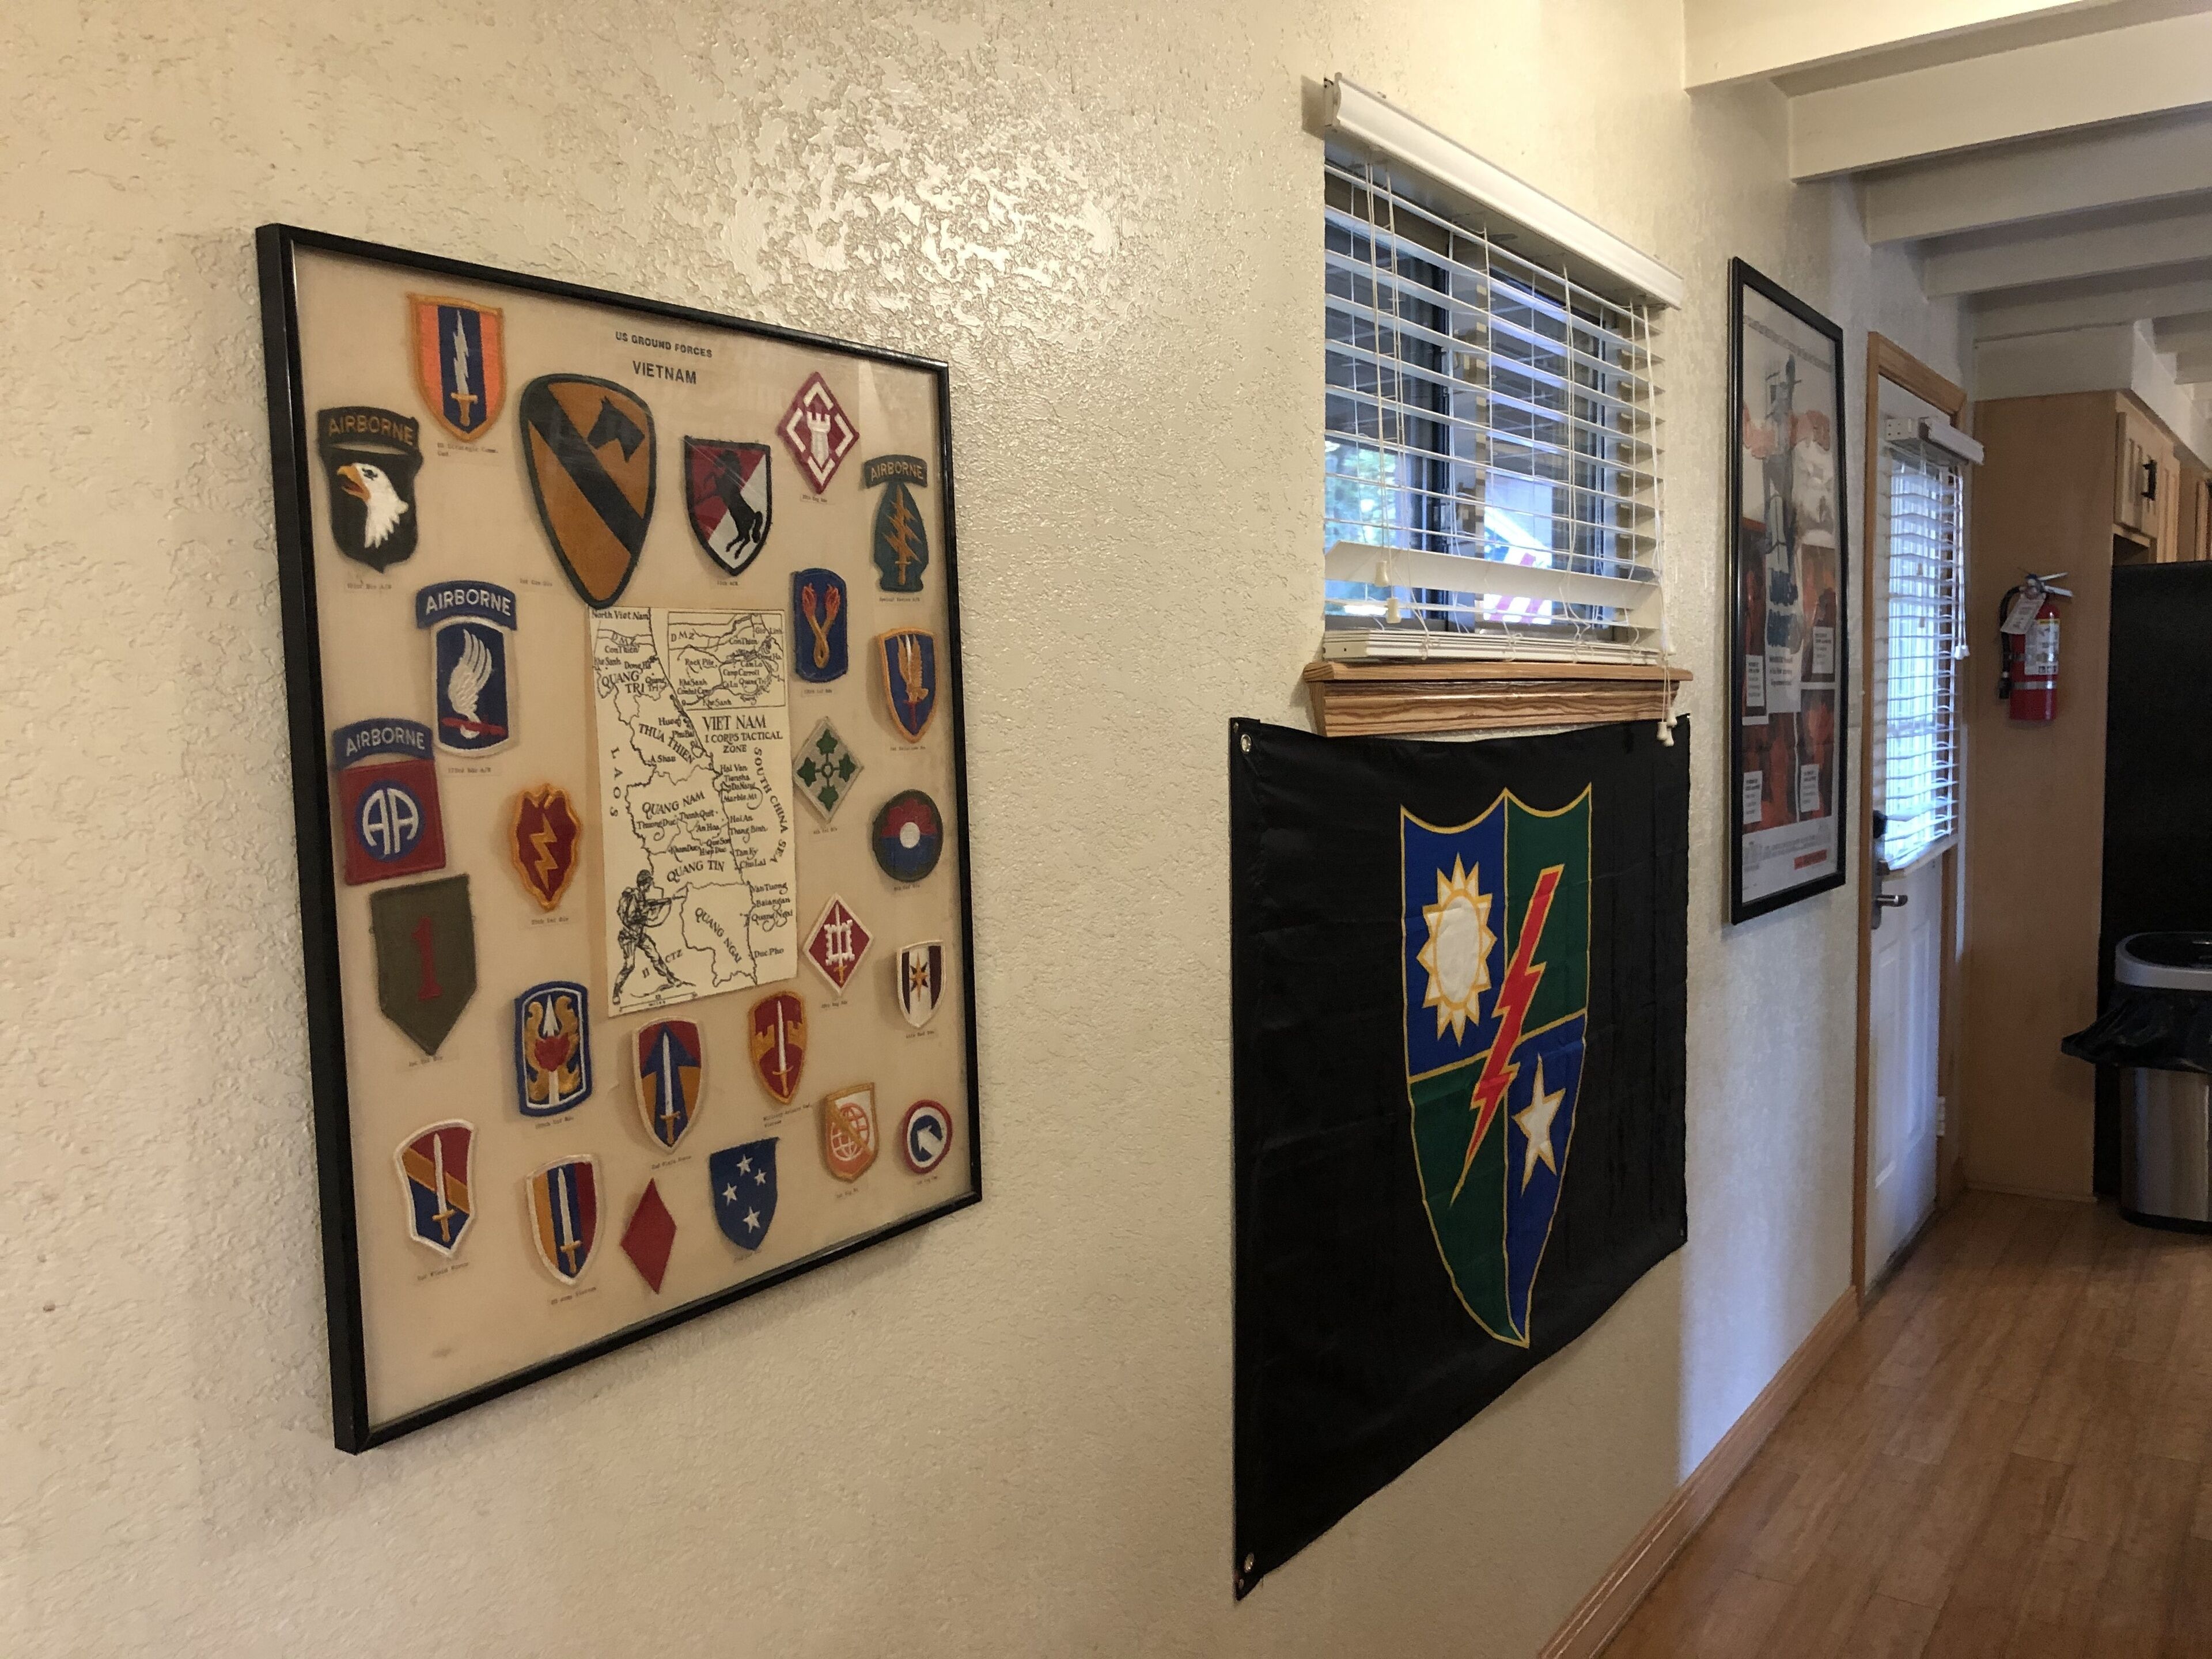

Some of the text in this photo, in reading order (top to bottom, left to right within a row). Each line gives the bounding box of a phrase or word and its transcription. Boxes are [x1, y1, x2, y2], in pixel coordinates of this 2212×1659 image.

[616, 331, 713, 358] US GROUND FORCES
[632, 360, 697, 385] VIETNAM
[328, 415, 414, 446] AIRBORNE
[871, 461, 923, 482] AIRBORNE
[426, 589, 511, 616] AIRBORNE
[592, 610, 649, 620] North Viet Nam
[601, 671, 639, 689] QUANG
[625, 683, 645, 694] TRI
[702, 714, 767, 732] VIET NAM
[346, 727, 425, 756] AIRBORNE
[638, 723, 695, 764] THUA THIEN
[705, 731, 783, 745] I CORPS TACTICAL
[723, 744, 747, 753] ZONE
[642, 790, 705, 820] QUANG NAM
[754, 747, 789, 863] SOUTH CHINA SEA
[362, 787, 420, 855] AA
[667, 860, 725, 883] QUANG TIN
[695, 907, 742, 963] QUANG NGAI
[411, 915, 443, 1001] 1
[754, 948, 784, 959] Duc Pho
